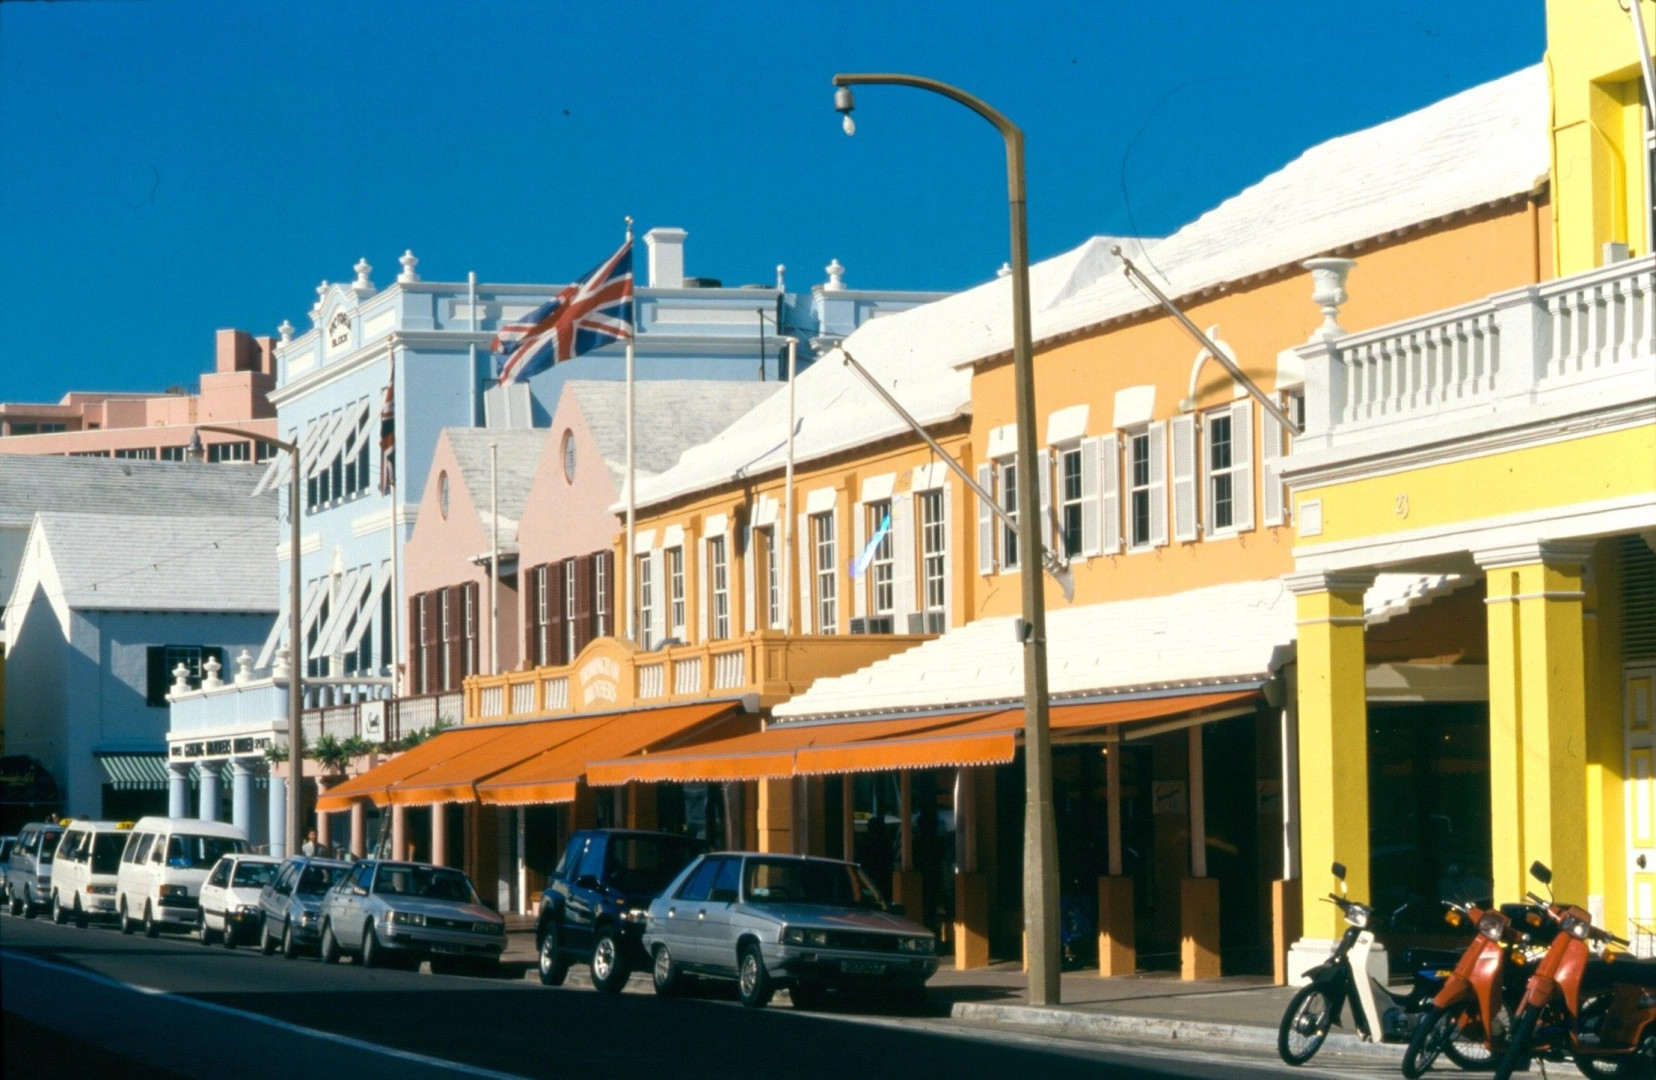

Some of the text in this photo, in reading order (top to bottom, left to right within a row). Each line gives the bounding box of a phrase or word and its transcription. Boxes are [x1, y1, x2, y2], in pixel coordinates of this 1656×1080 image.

[329, 312, 352, 338] VICTORIA
[331, 333, 349, 348] BLOCK
[1394, 493, 1409, 520] 23
